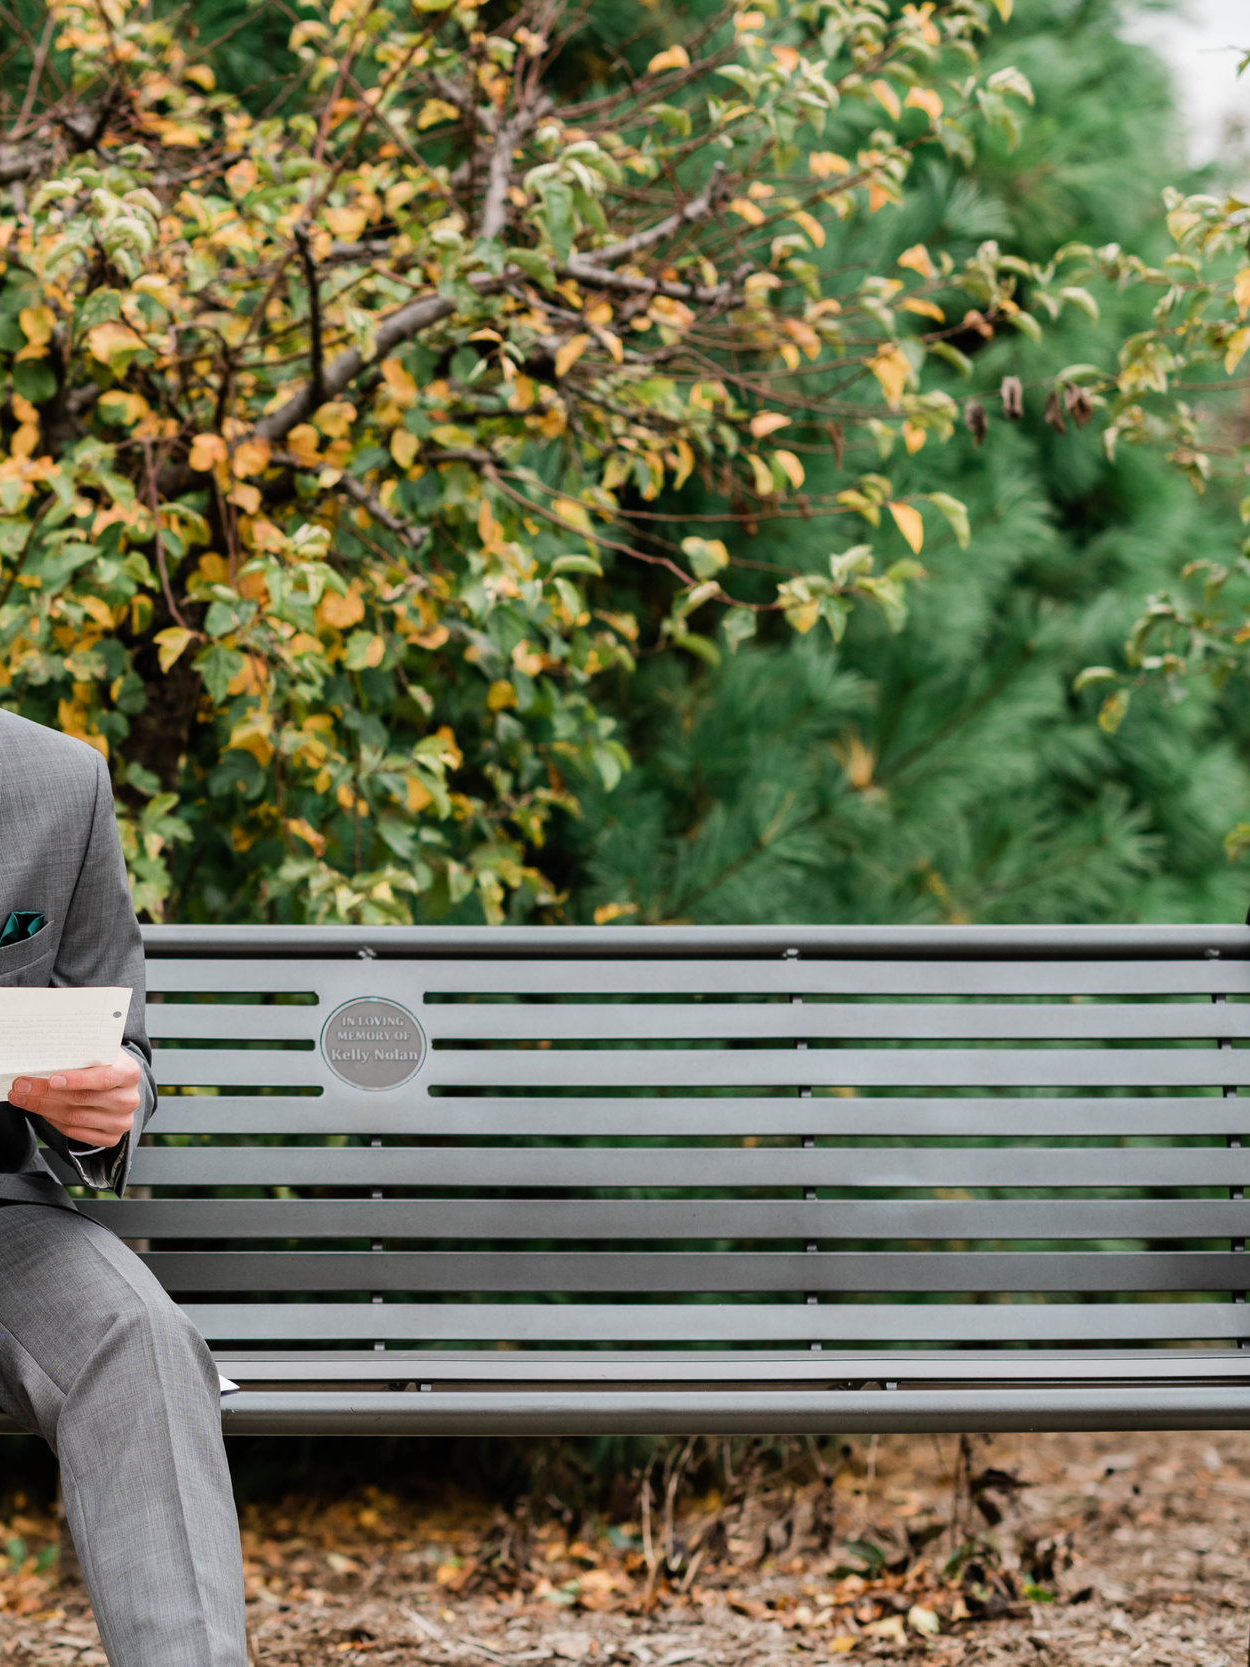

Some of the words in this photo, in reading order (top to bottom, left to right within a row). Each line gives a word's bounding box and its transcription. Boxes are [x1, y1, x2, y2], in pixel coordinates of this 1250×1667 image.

[341, 1016, 355, 1026] IN
[358, 1016, 404, 1026] LOVING
[337, 1031, 392, 1041] MEMORY
[394, 1031, 411, 1041] OF
[331, 1049, 370, 1063] Kelly
[375, 1049, 418, 1061] Nolan
